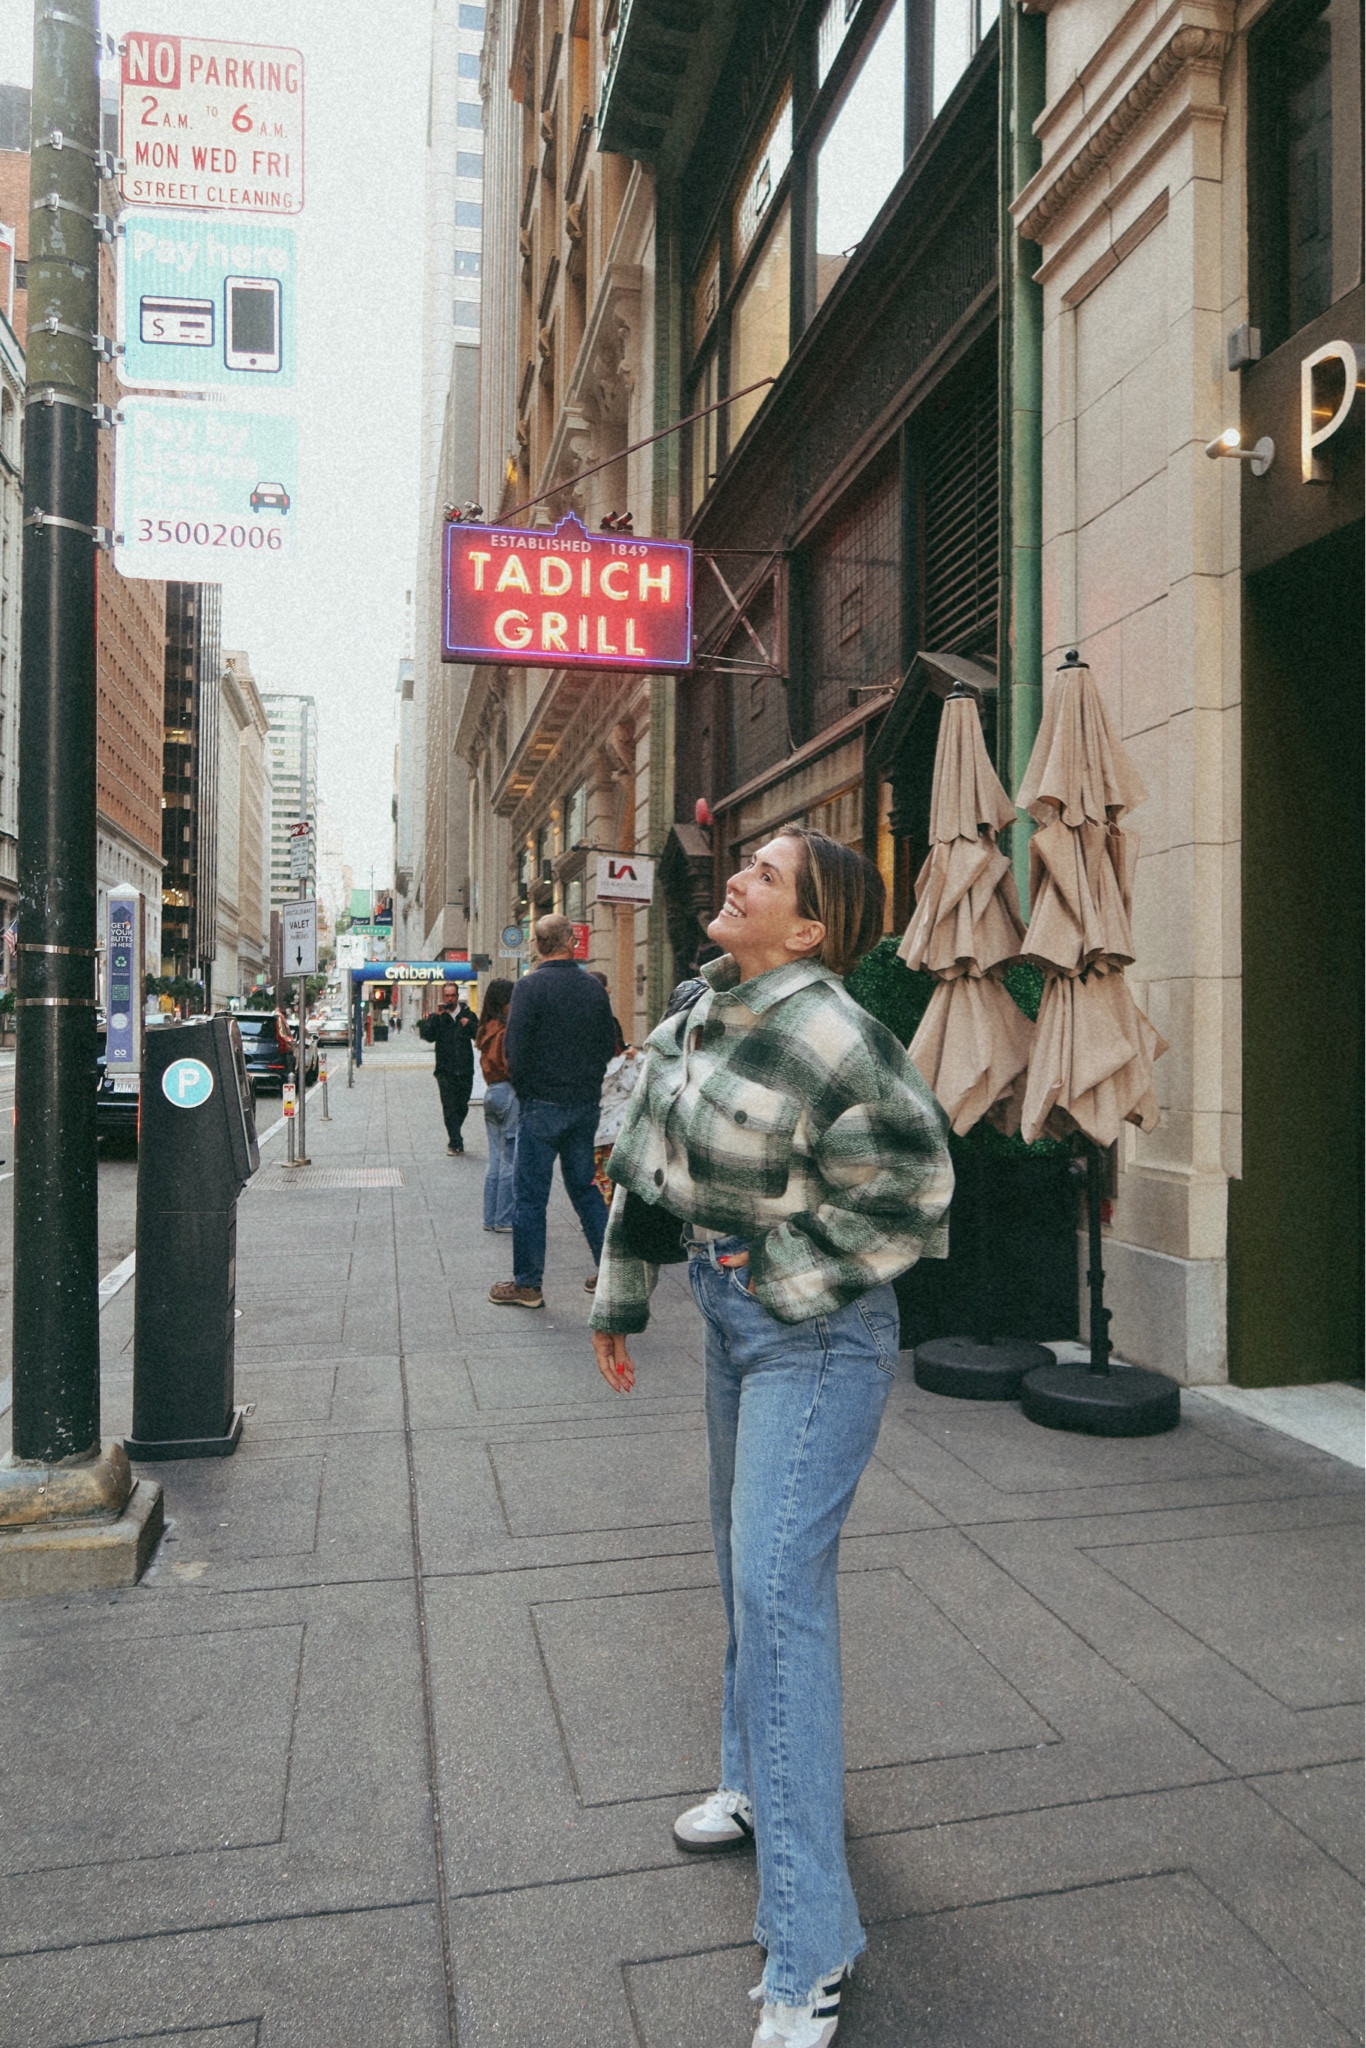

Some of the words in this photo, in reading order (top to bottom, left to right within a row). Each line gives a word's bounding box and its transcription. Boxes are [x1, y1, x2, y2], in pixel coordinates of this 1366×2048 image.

[128, 40, 176, 84] NO
[190, 55, 298, 93] PARKING
[141, 96, 158, 126] 2
[163, 114, 193, 130] A.M.
[206, 106, 218, 117] TO
[232, 104, 253, 133] 6
[260, 122, 288, 138] A.M.
[135, 141, 178, 169] MON
[192, 146, 237, 174] WED
[253, 151, 289, 177] FRI
[134, 180, 198, 200] STREET
[207, 187, 292, 208] CLEANING
[134, 230, 199, 273] Pay
[206, 233, 288, 272] here
[1301, 339, 1357, 485] P
[138, 518, 283, 550] 35002006
[491, 535, 591, 553] ESTABLISHED
[610, 543, 648, 557] 1849
[468, 551, 671, 603] TADICH
[494, 609, 646, 656] GRILL
[289, 920, 309, 929] VALET
[356, 927, 387, 935] Battery
[385, 964, 445, 979] citibank
[178, 1068, 200, 1099] P
